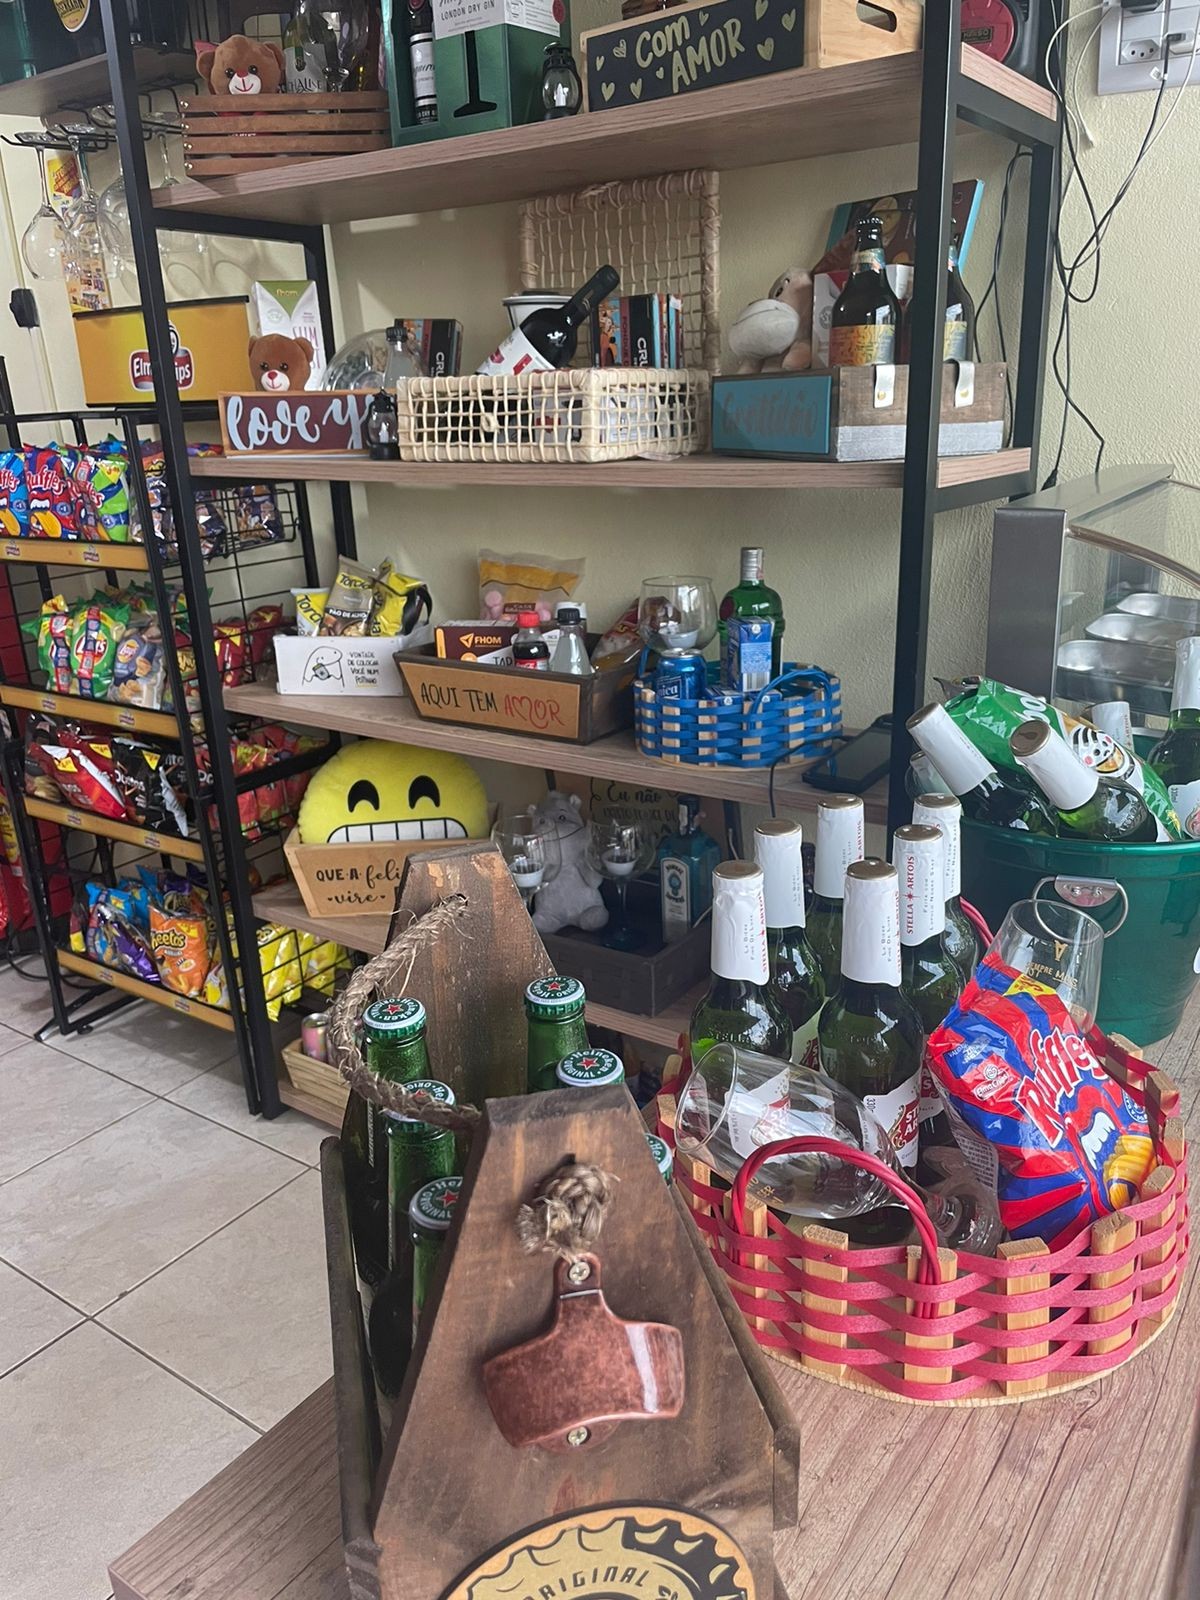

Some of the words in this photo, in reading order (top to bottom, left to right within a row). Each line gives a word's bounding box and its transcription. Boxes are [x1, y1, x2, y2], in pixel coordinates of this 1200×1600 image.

[441, 7, 467, 21] LONDON
[468, 4, 482, 15] DRY
[483, 0, 496, 11] GIN
[671, 18, 746, 94] AMOR
[133, 357, 152, 378] Elm
[174, 362, 191, 385] ips
[227, 396, 320, 451] love
[474, 635, 502, 645] FHOM
[421, 682, 461, 709] AQUI
[462, 690, 498, 713] TEM
[504, 694, 565, 729] AMOR
[316, 868, 344, 881] QUE
[350, 868, 359, 880] A
[366, 859, 400, 889] feli
[906, 856, 916, 890] ARTOIS
[334, 891, 379, 904] vire
[906, 903, 914, 934] STELLA
[151, 930, 186, 950] heetos
[563, 1060, 596, 1079] ORIGINAL
[572, 1049, 614, 1073] Heineken
[1016, 1025, 1110, 1148] Ruffles
[523, 1564, 649, 1600] RIGINAL
